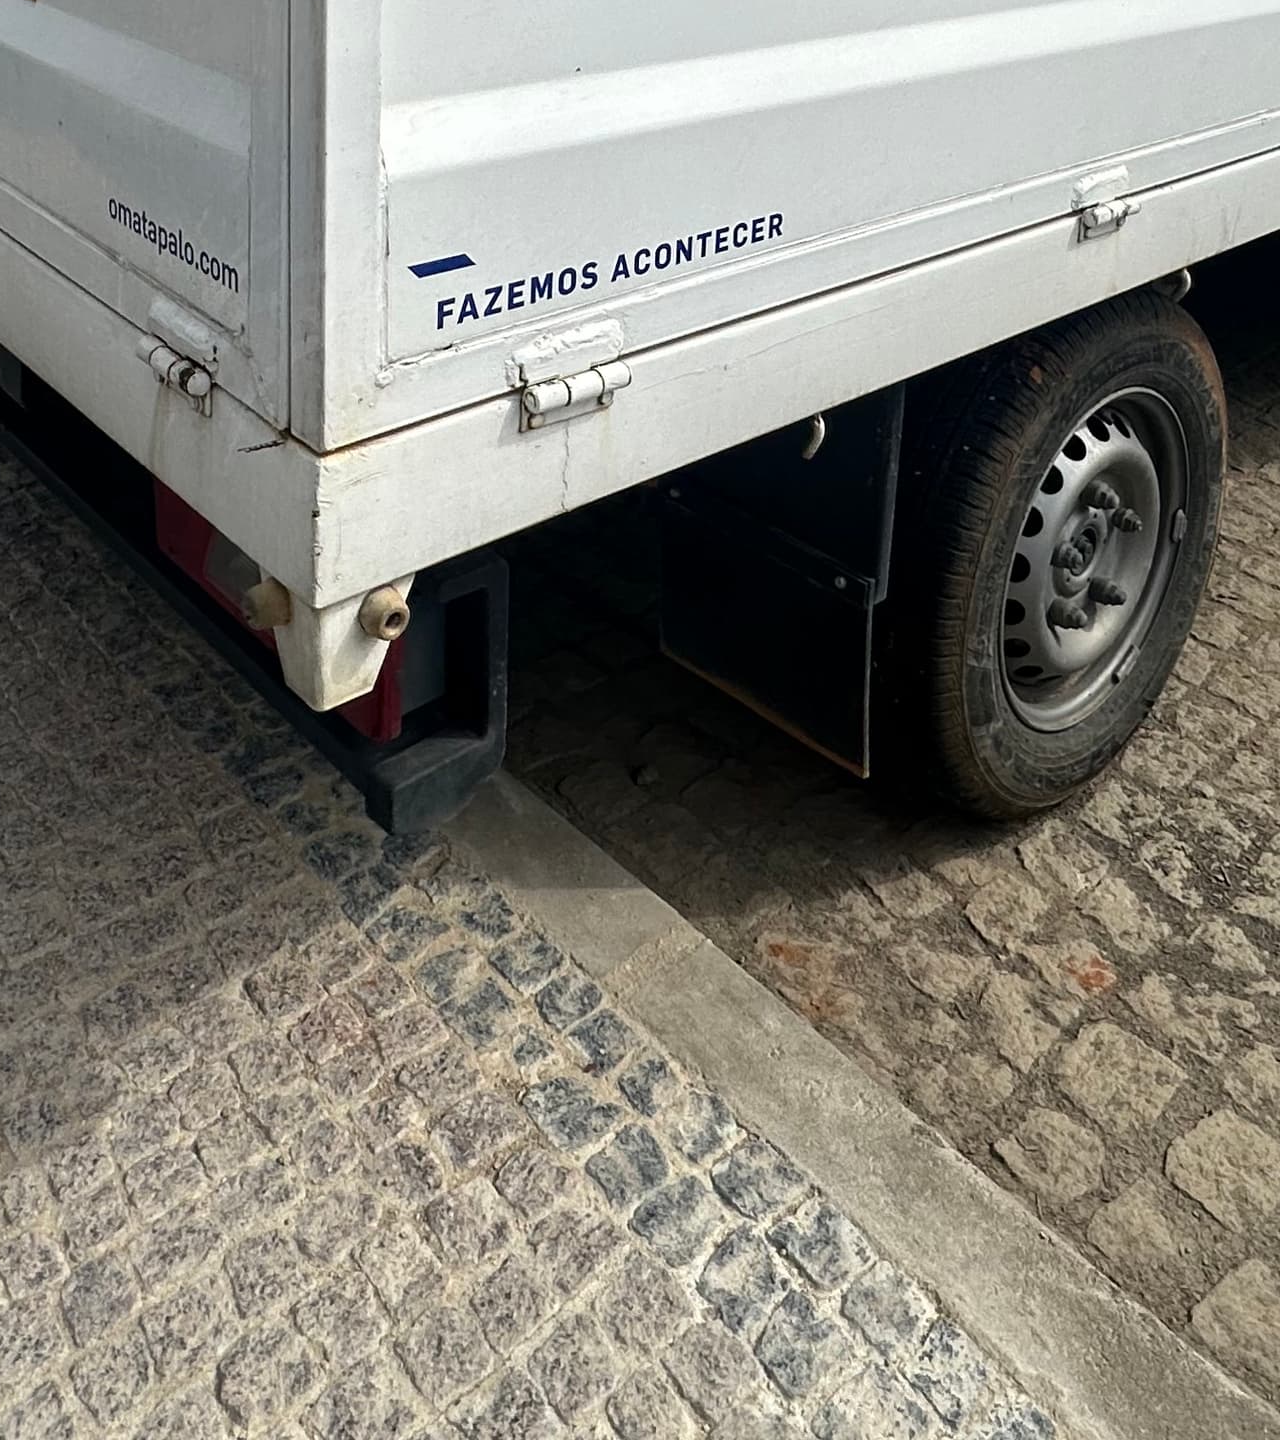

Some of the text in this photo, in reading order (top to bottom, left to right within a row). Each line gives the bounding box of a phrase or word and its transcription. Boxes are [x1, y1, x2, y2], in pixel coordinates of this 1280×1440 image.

[109, 198, 239, 293] omatapalo.com
[436, 213, 784, 330] FAZEMOS ACONTECER
